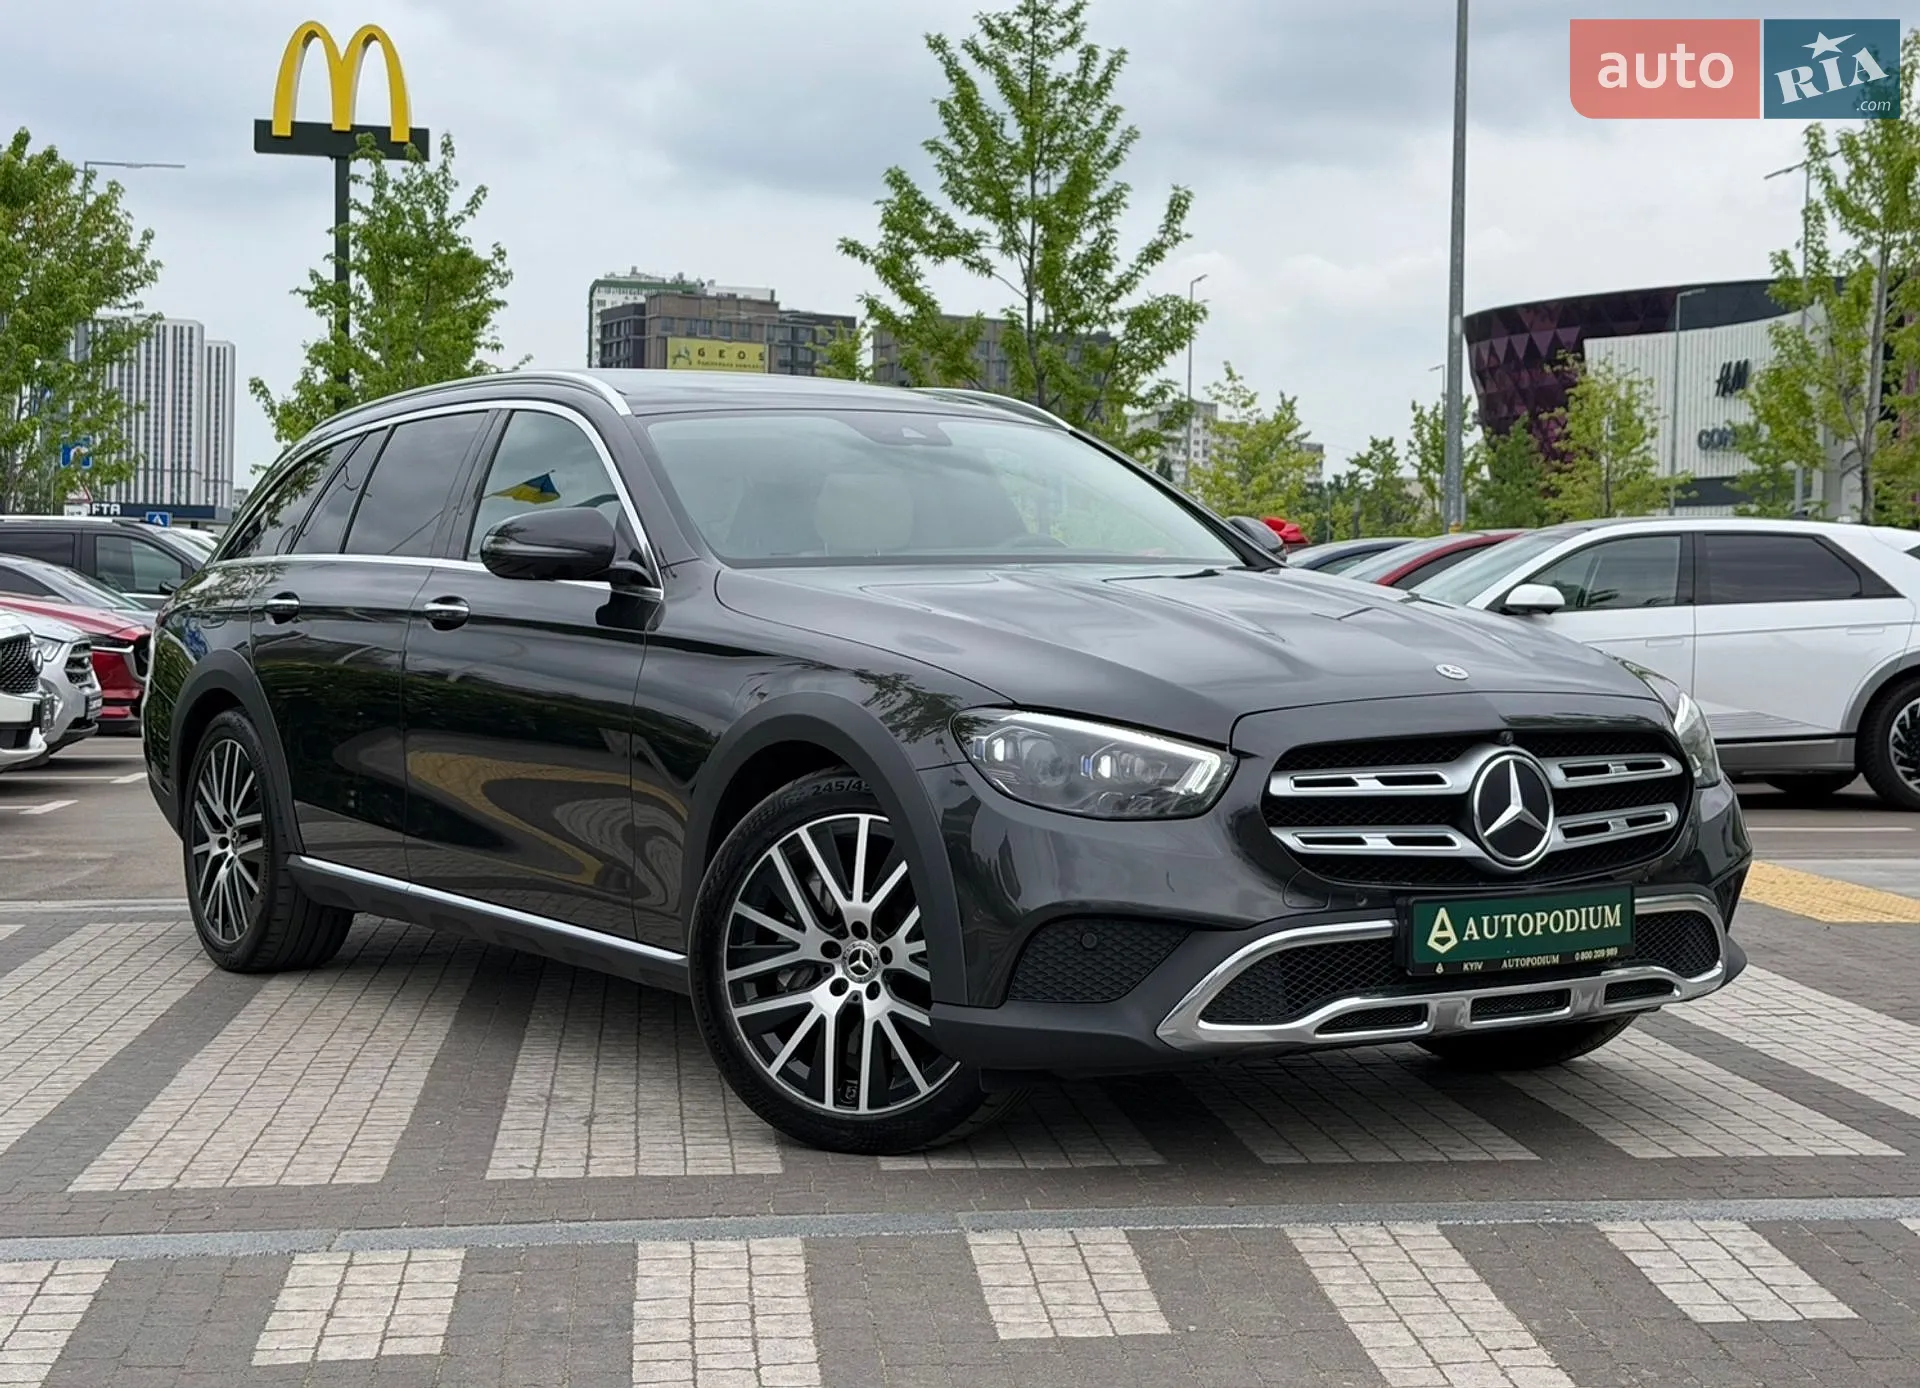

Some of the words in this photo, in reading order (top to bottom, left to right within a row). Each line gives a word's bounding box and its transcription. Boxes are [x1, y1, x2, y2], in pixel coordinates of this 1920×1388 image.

[1462, 904, 1622, 941] AUTOPODIUM
[1462, 961, 1484, 972] KYIV
[1501, 954, 1560, 969] AUTOPODIUM
